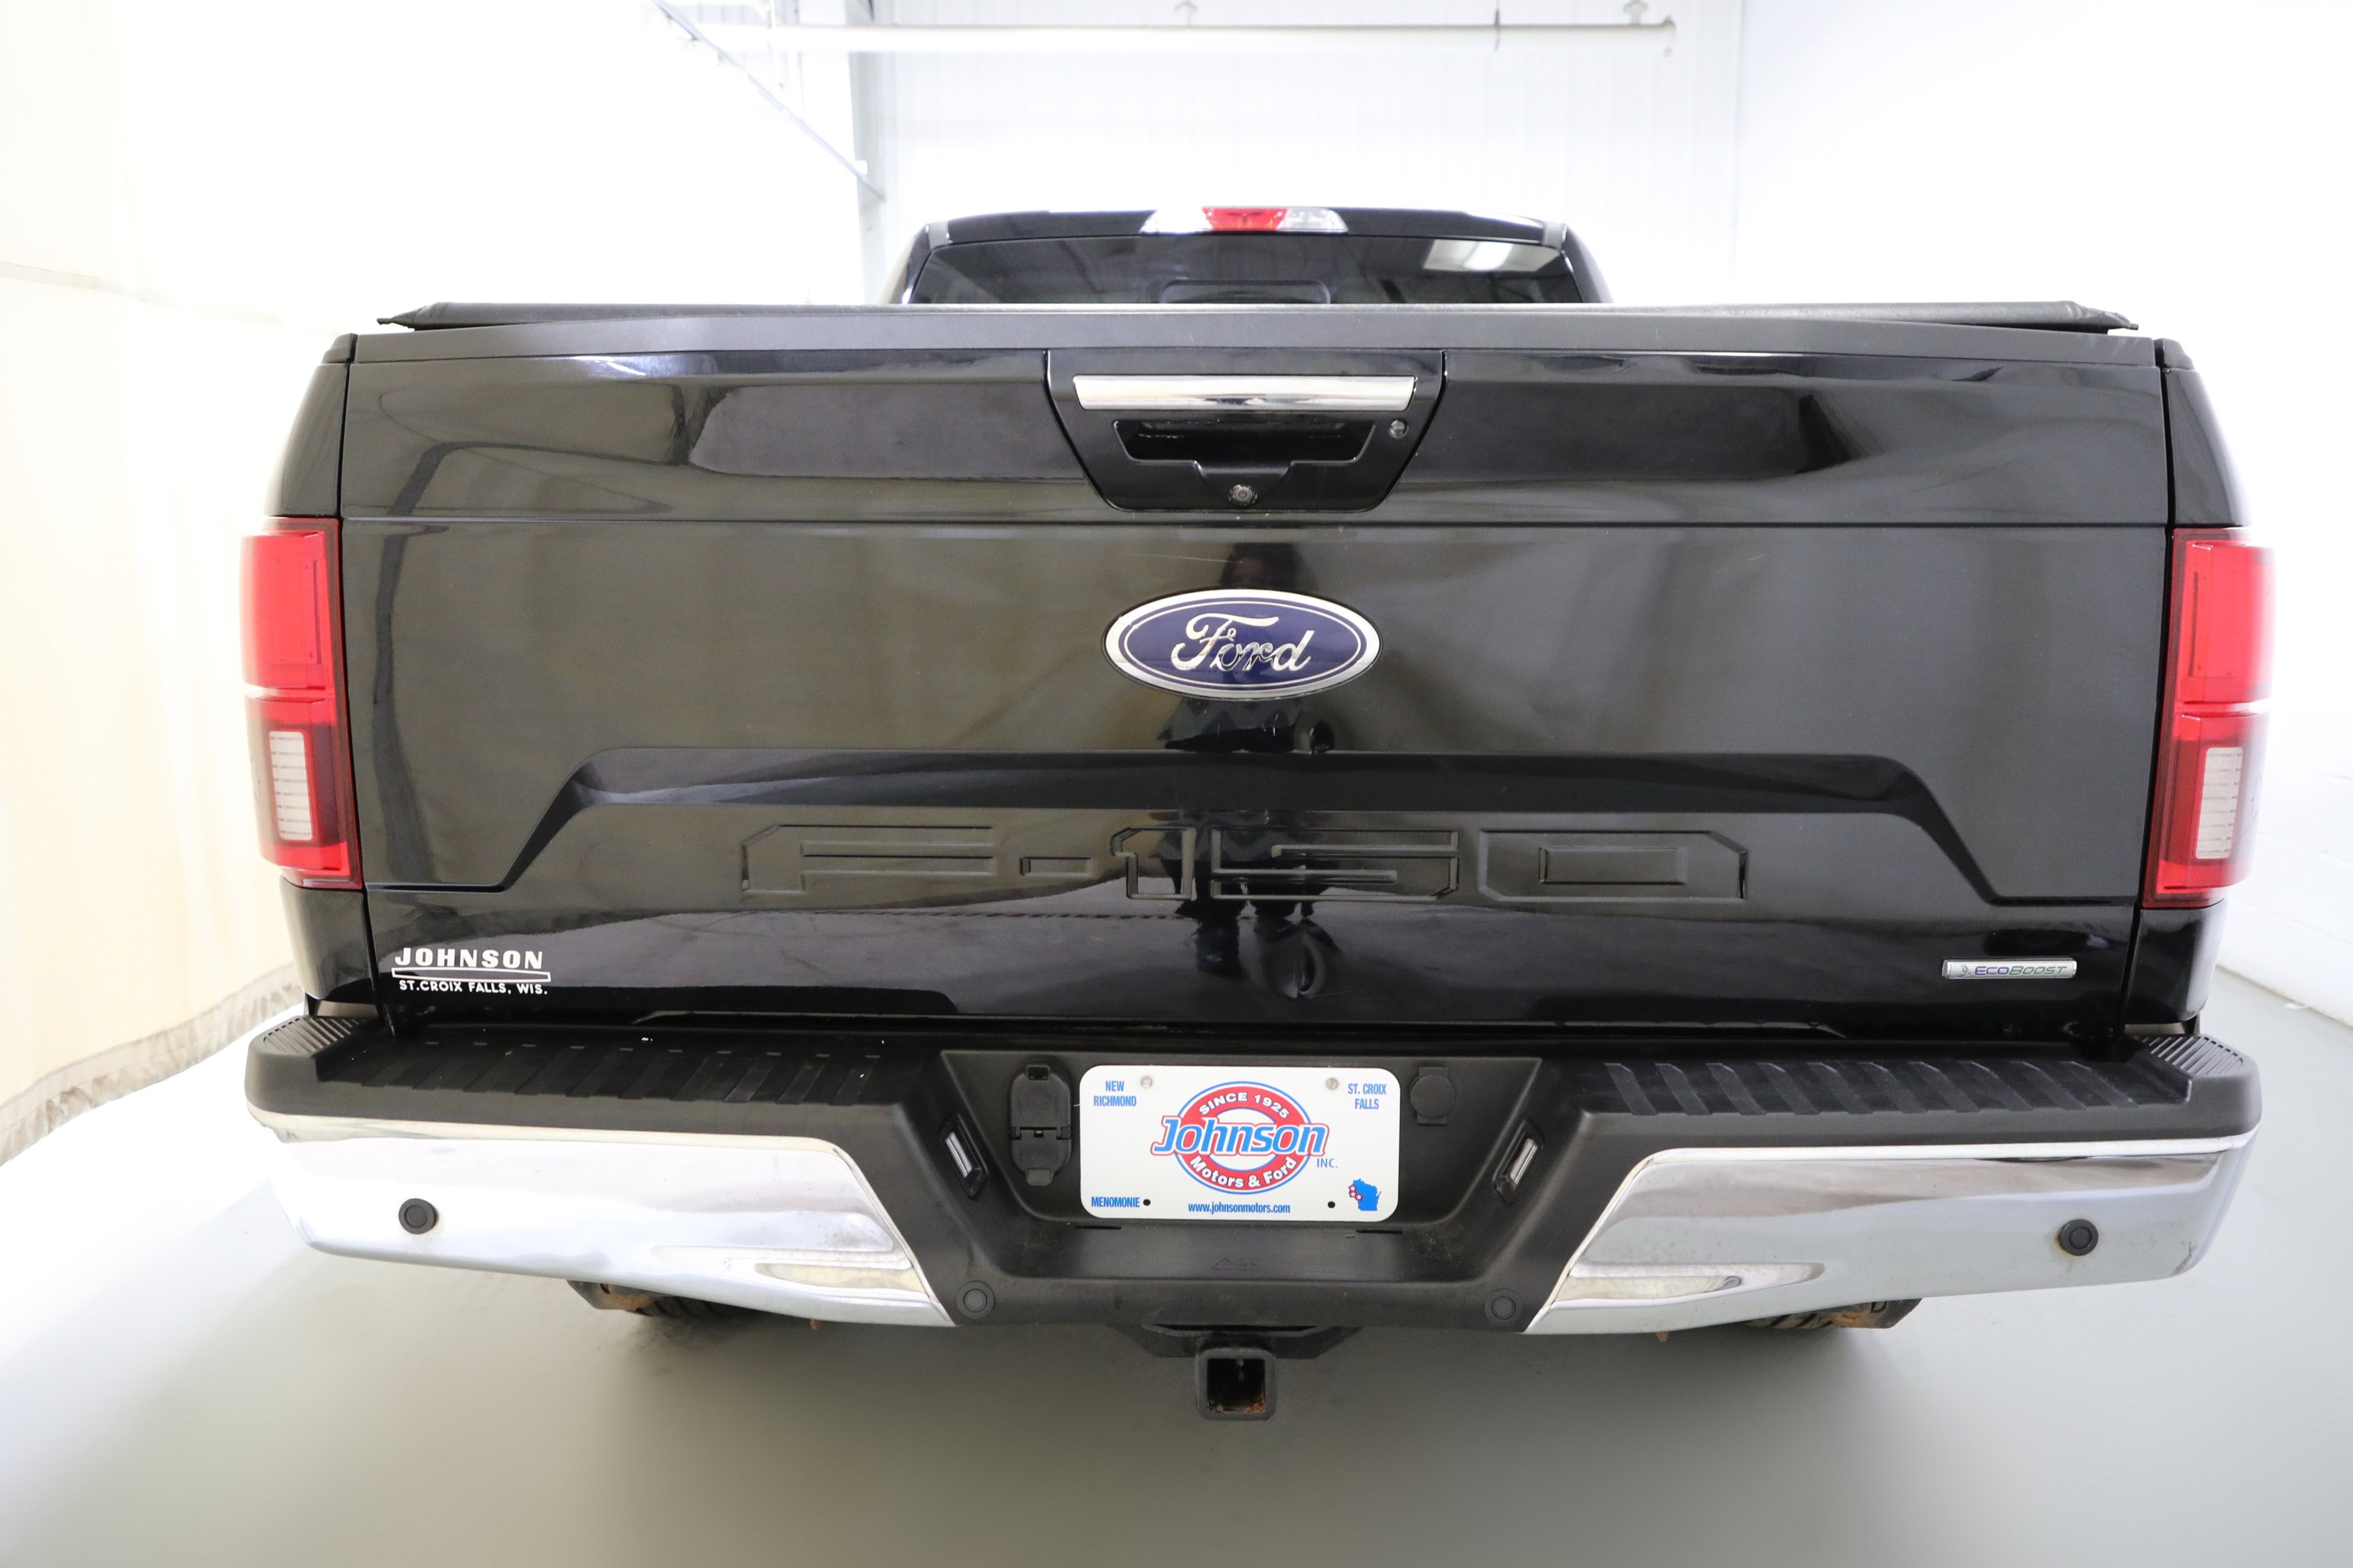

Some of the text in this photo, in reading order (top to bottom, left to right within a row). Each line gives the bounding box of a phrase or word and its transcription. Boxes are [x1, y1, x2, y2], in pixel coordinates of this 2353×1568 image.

[1171, 613, 1315, 672] Ford
[741, 824, 1748, 902] F-150
[394, 947, 543, 969] JOHNSON
[468, 982, 511, 994] FALLS,
[516, 983, 548, 994] WIS.
[1105, 1081, 1124, 1092] NEW
[1348, 1083, 1386, 1094] ST. CROIX
[1094, 1095, 1136, 1106] RICHMOND
[1199, 1092, 1289, 1118] SINCE 1925
[1355, 1098, 1379, 1110] FALLS
[1153, 1117, 1327, 1155] Johnson
[1317, 1158, 1338, 1168] INC.
[1190, 1156, 1297, 1188] Motors & Ford
[1091, 1197, 1140, 1208] MENOMONIE
[1188, 1202, 1291, 1214] www.johnsonmotors.com
